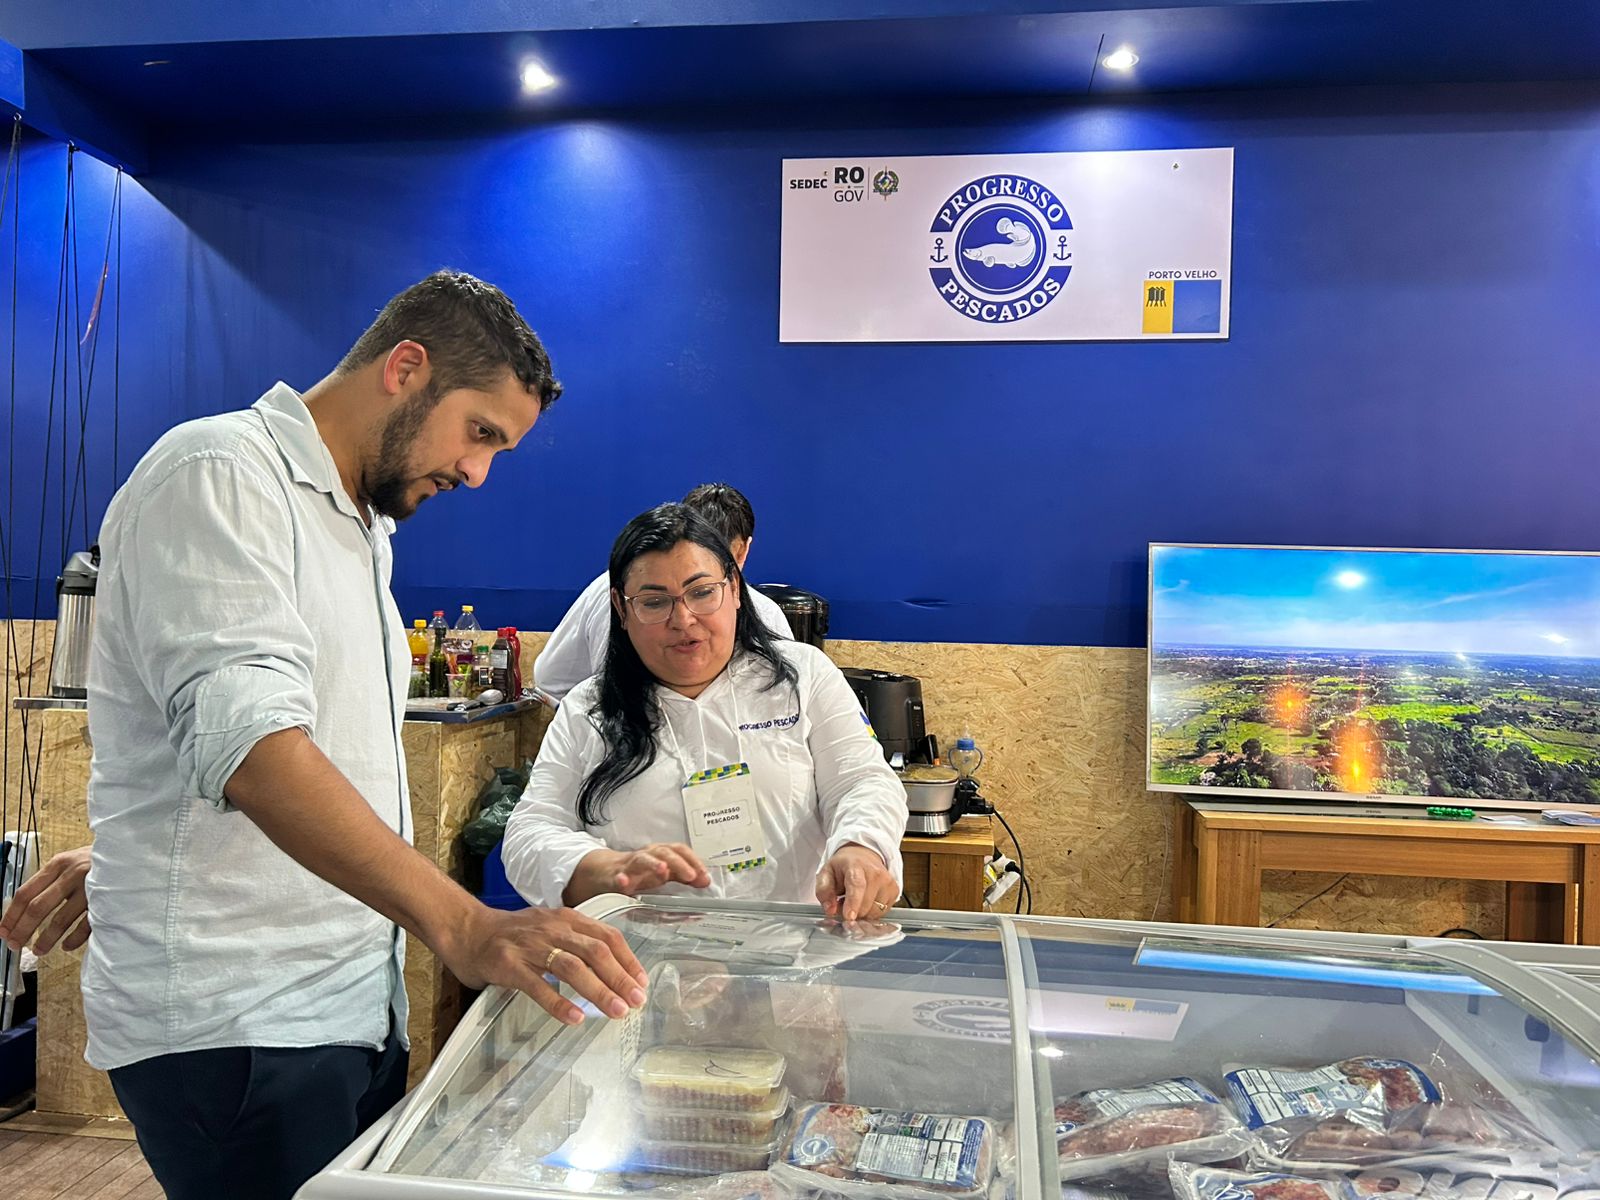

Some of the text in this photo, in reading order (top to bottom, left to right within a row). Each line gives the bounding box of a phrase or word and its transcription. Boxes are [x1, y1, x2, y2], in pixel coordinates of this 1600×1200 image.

[834, 166, 865, 184] RO
[789, 178, 828, 189] SEDEC
[834, 189, 864, 203] GOV
[939, 177, 1064, 227] PROGRESSO
[1148, 269, 1218, 280] PORTO VELHO
[939, 277, 1062, 322] PESCADOS
[706, 814, 740, 825] PESCADOS
